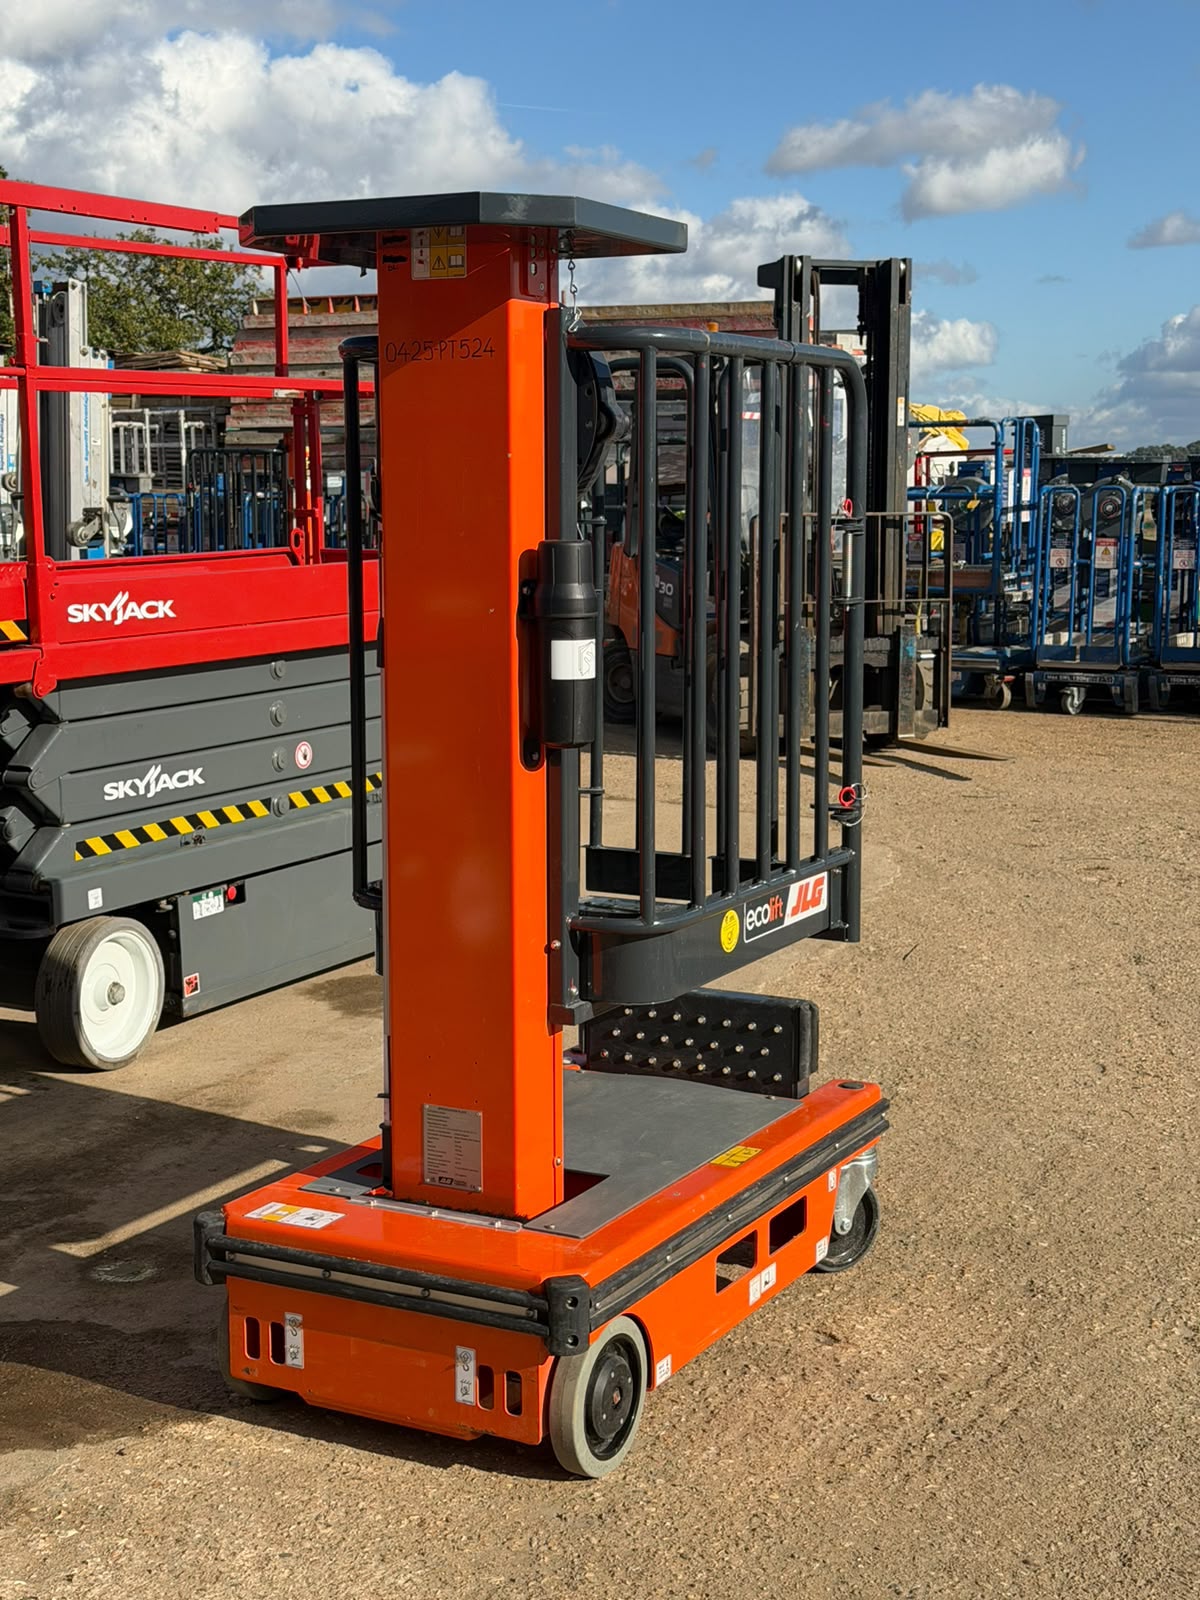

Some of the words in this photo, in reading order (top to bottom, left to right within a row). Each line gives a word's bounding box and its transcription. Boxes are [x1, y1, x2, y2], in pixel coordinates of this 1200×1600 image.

[67, 591, 176, 625] SKYJACK
[103, 764, 205, 801] SKYJACK
[746, 894, 784, 931] ecolift
[790, 876, 825, 917] JLG
